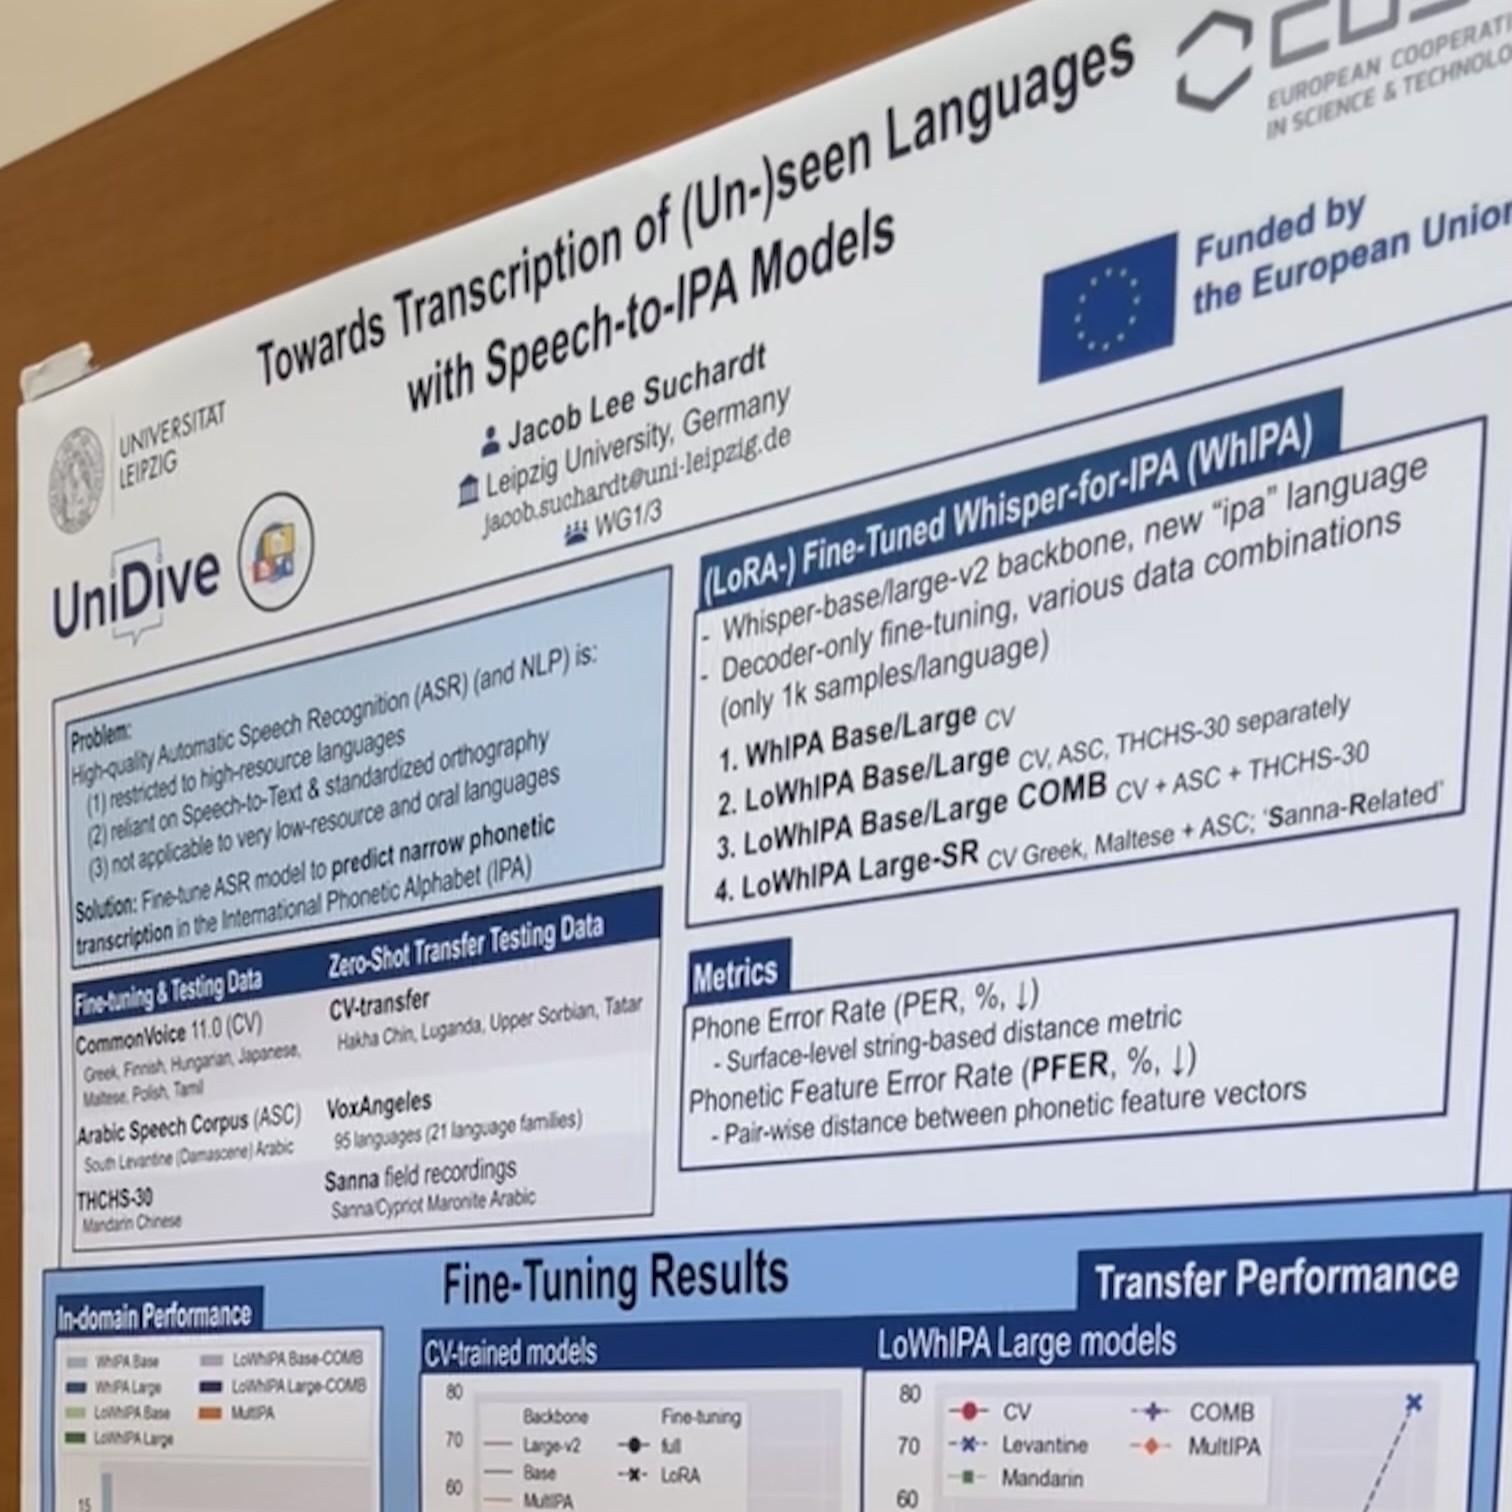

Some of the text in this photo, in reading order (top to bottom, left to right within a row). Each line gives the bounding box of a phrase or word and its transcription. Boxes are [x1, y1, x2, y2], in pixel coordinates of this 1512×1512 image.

[1269, 0, 1472, 69] CO
[1265, 117, 1287, 141] IN
[1292, 87, 1375, 132] SCIENCE
[1383, 79, 1398, 102] &
[1266, 56, 1381, 111] EUROPEAN
[255, 32, 1135, 386] Towards Transcription of (Un-)seen Languages
[1195, 193, 1367, 268] Funded by
[1192, 280, 1242, 316] the
[1252, 231, 1410, 299] European
[406, 206, 895, 413] with Speech-to-IPA Models
[507, 341, 767, 450] Jacob Lee Suchardt
[119, 448, 178, 491] LEIPZIG
[486, 385, 792, 499] Leipzig University, Germany
[481, 424, 792, 541] jacob.suchardt@uni-leipzig.de
[703, 411, 1313, 607] (LoRA-) Fine-Tuned Whisper-for-IPA (WhIPA)
[594, 496, 663, 538] WG1/3
[722, 554, 989, 643] Whisper-base/large-v2
[996, 528, 1134, 579] backbone,
[1144, 510, 1204, 545] new
[1286, 456, 1429, 511] language
[53, 551, 221, 640] UniDive
[720, 627, 1050, 728] (only 1k samples/language)
[70, 722, 132, 754] Problem:
[717, 692, 1352, 818] 2. LoWhIPA Base/Large CV, ASC, THCHS-30 separately
[719, 704, 1017, 773] 1. WhIPA Base/Large CV
[86, 728, 551, 852] (2) reliant on Speech-to-Text & standardized orthography
[327, 913, 605, 980] Zero-Shot Transfer Testing Data
[692, 955, 779, 995] Metrics
[75, 1010, 263, 1056] CommonVoice 11.0 (CV)
[328, 987, 431, 1022] CV-transfer
[690, 1015, 761, 1043] Phone
[767, 1005, 825, 1034] Error
[830, 997, 886, 1027] Rate
[893, 985, 965, 1025] (PER,
[77, 1101, 302, 1145] Arabic Speech Corpus (ASC)
[326, 1090, 433, 1120] VoxAngeles
[443, 1247, 789, 1311] Fine-Tuning Results
[1094, 1256, 1460, 1301] Transfer Performance
[57, 1300, 253, 1331] In-domain Performance
[877, 1321, 1178, 1366] LoWhIPA Large models
[423, 1335, 598, 1368] CV-trained models
[660, 1406, 743, 1430] Fine-tuning
[1002, 1401, 1033, 1423] CV
[1189, 1401, 1256, 1423] COMB
[1001, 1433, 1090, 1455] Levantine
[1001, 1467, 1085, 1489] Mandarin
